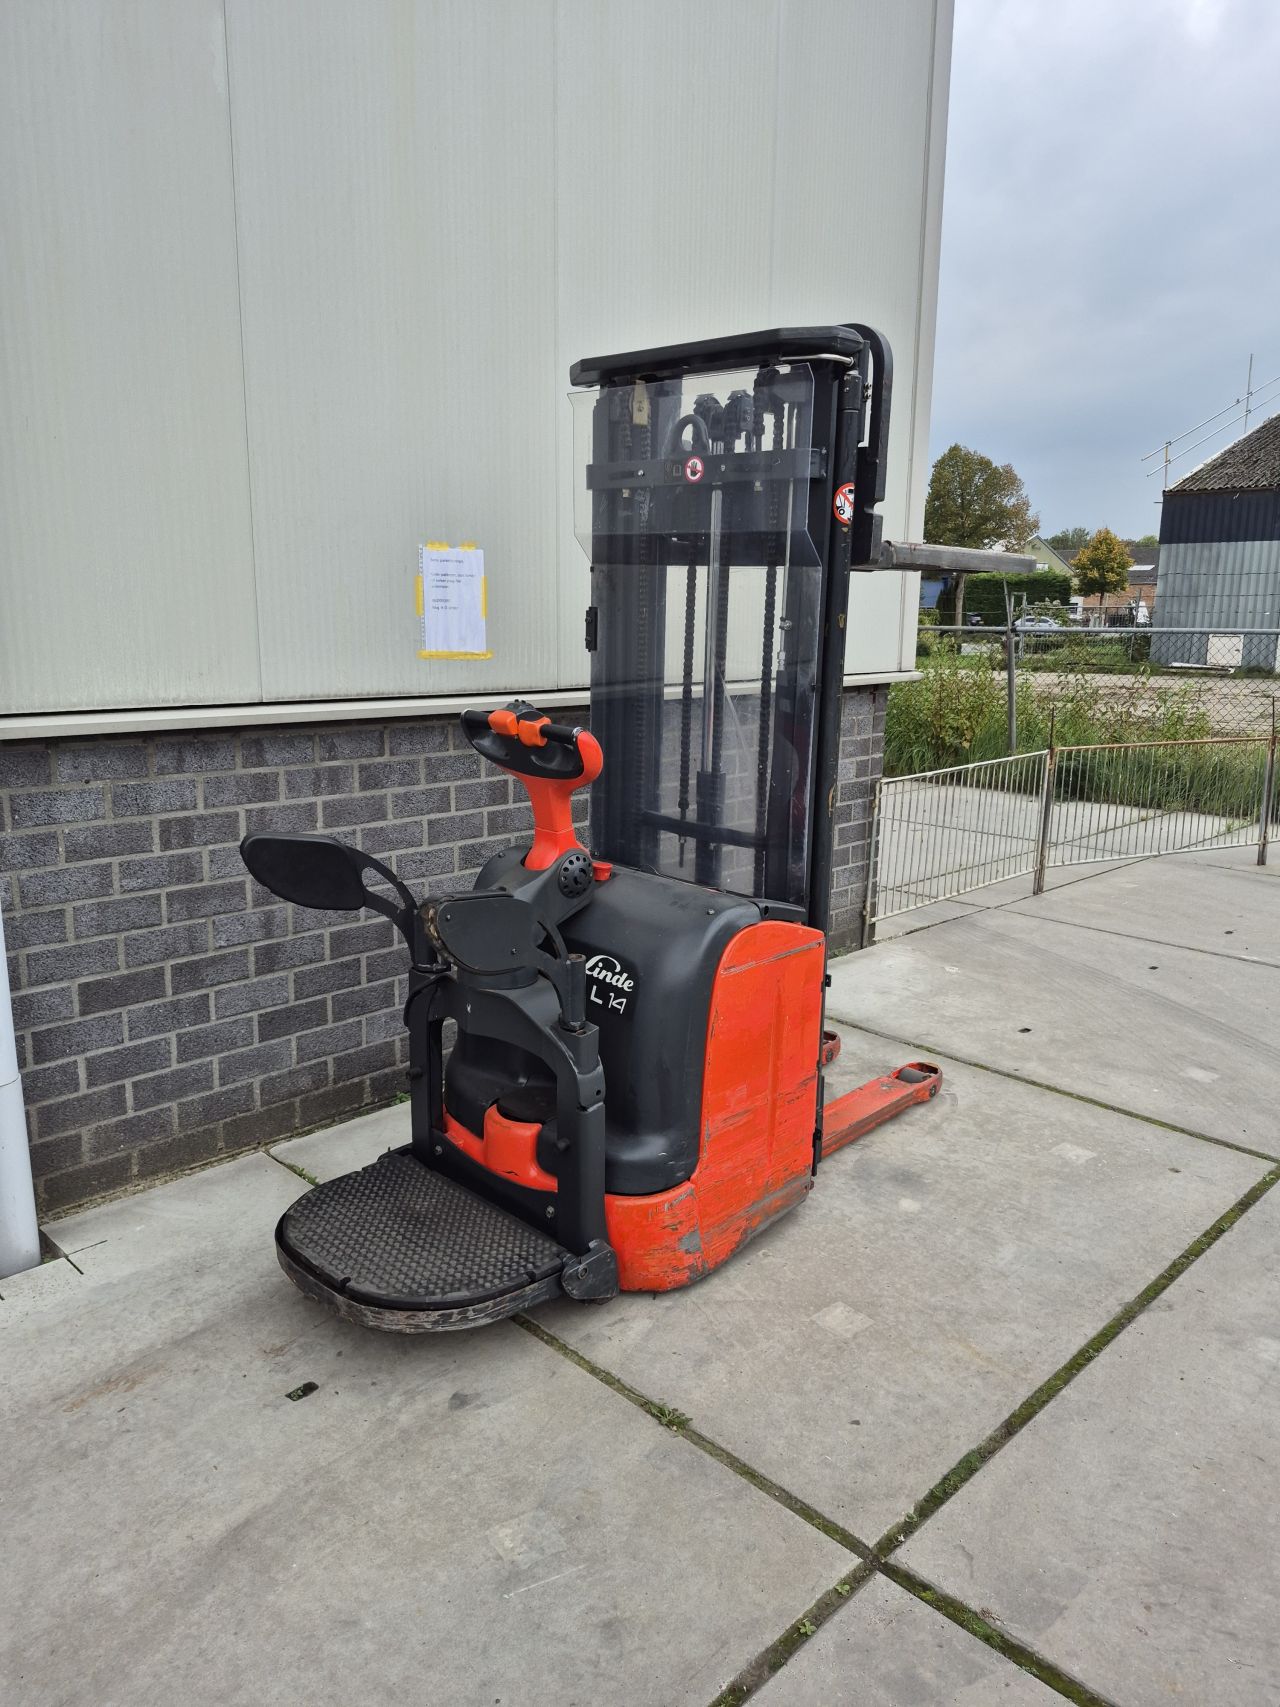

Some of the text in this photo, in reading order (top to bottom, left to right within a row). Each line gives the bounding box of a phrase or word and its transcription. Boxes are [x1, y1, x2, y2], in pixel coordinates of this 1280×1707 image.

[585, 955, 634, 991] Linde
[590, 985, 627, 1014] L 14
